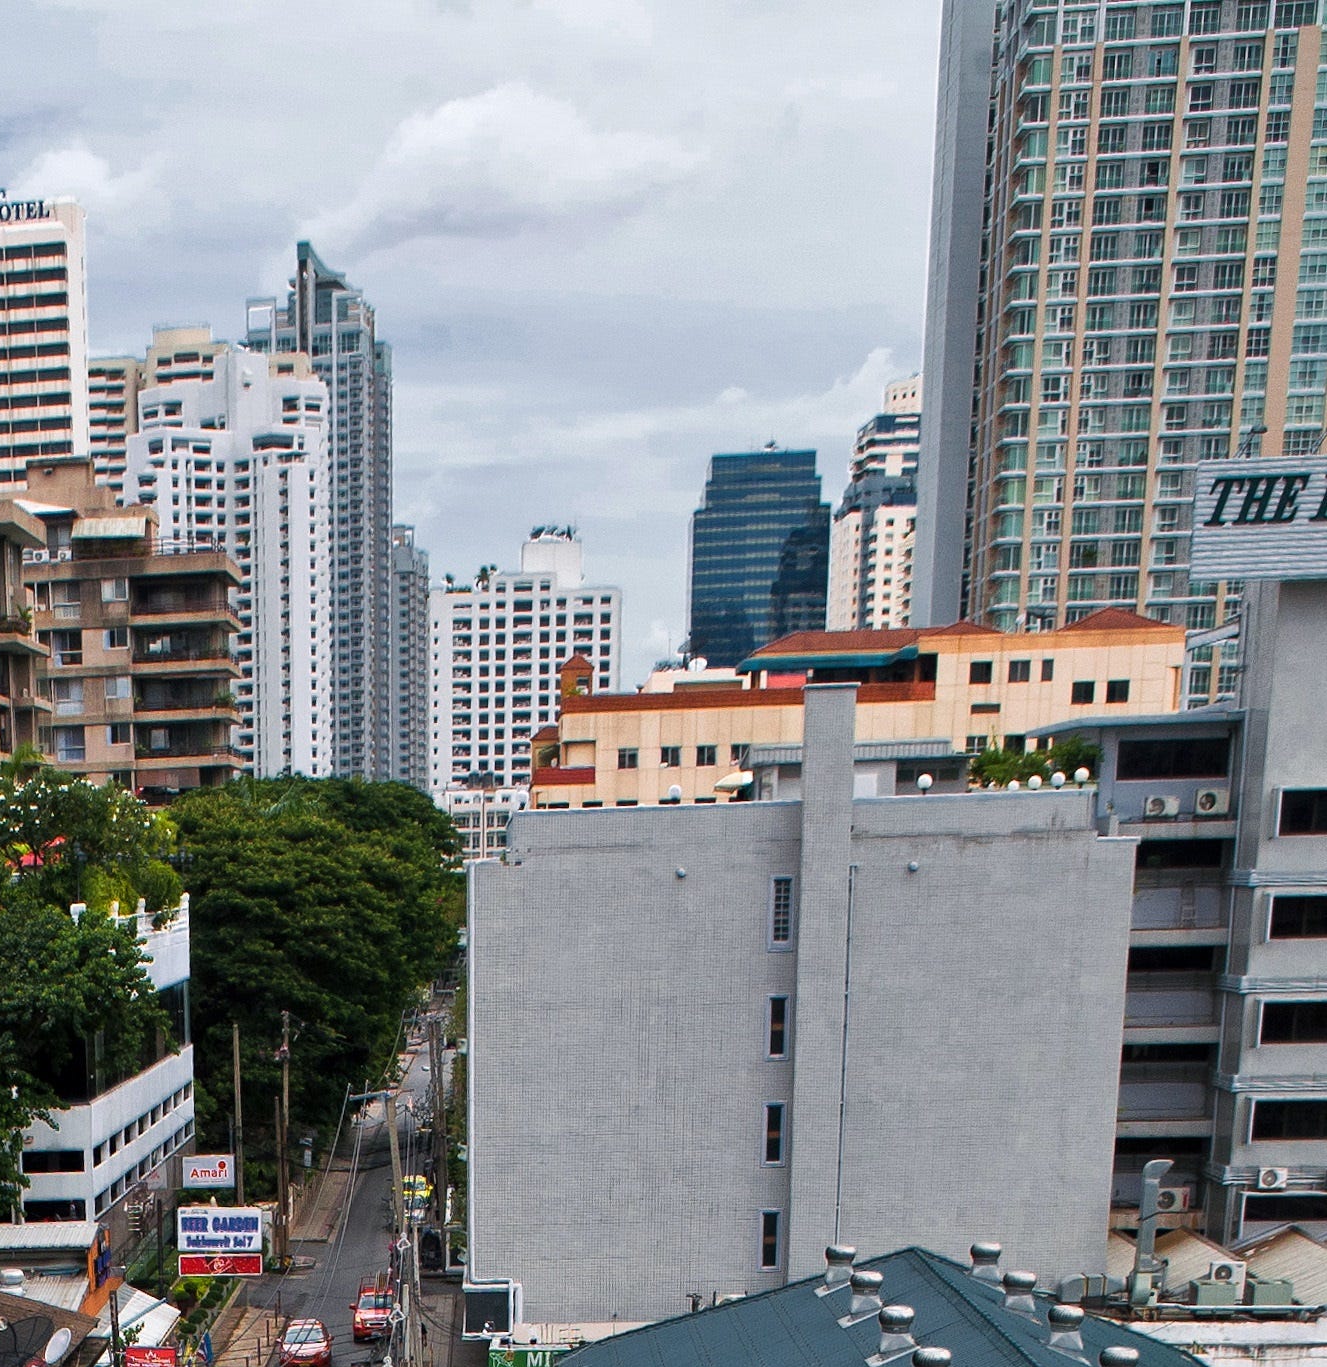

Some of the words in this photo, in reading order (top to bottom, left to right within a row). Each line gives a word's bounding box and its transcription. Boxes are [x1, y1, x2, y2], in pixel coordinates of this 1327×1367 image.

[1203, 473, 1311, 527] THE
[190, 1167, 228, 1178] Amari
[181, 1217, 208, 1233] BEER
[212, 1216, 259, 1233] GARDEN
